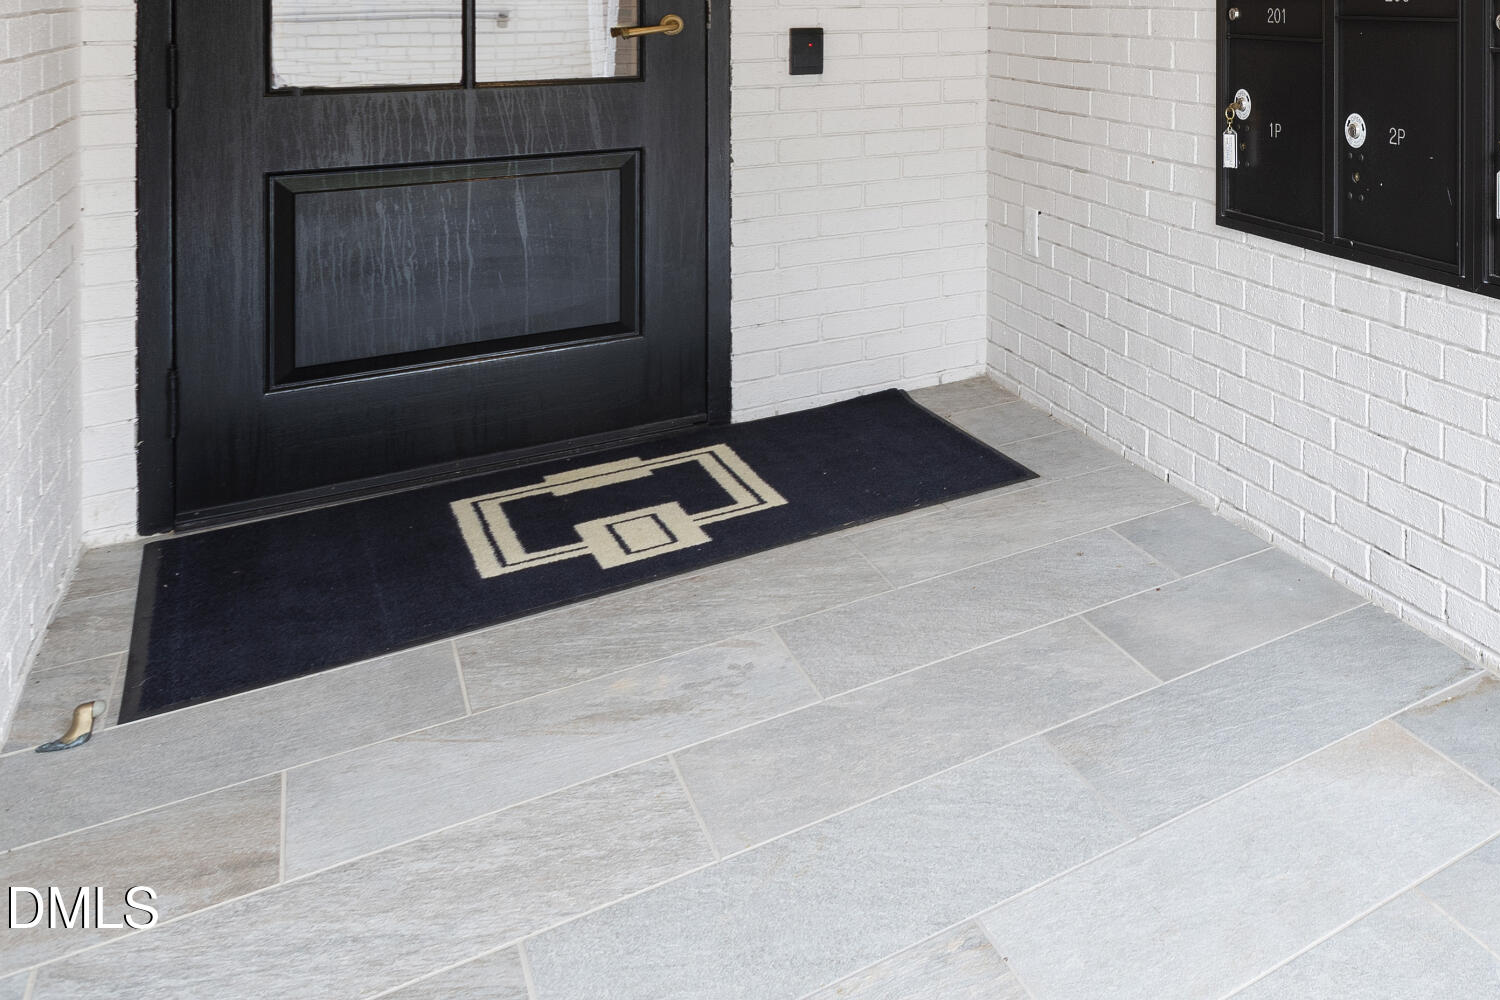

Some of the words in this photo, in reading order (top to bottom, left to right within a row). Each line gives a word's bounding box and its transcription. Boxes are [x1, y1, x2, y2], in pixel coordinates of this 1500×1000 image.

[1267, 7, 1286, 24] 201
[1269, 122, 1282, 138] 1P
[1389, 127, 1406, 146] 2P
